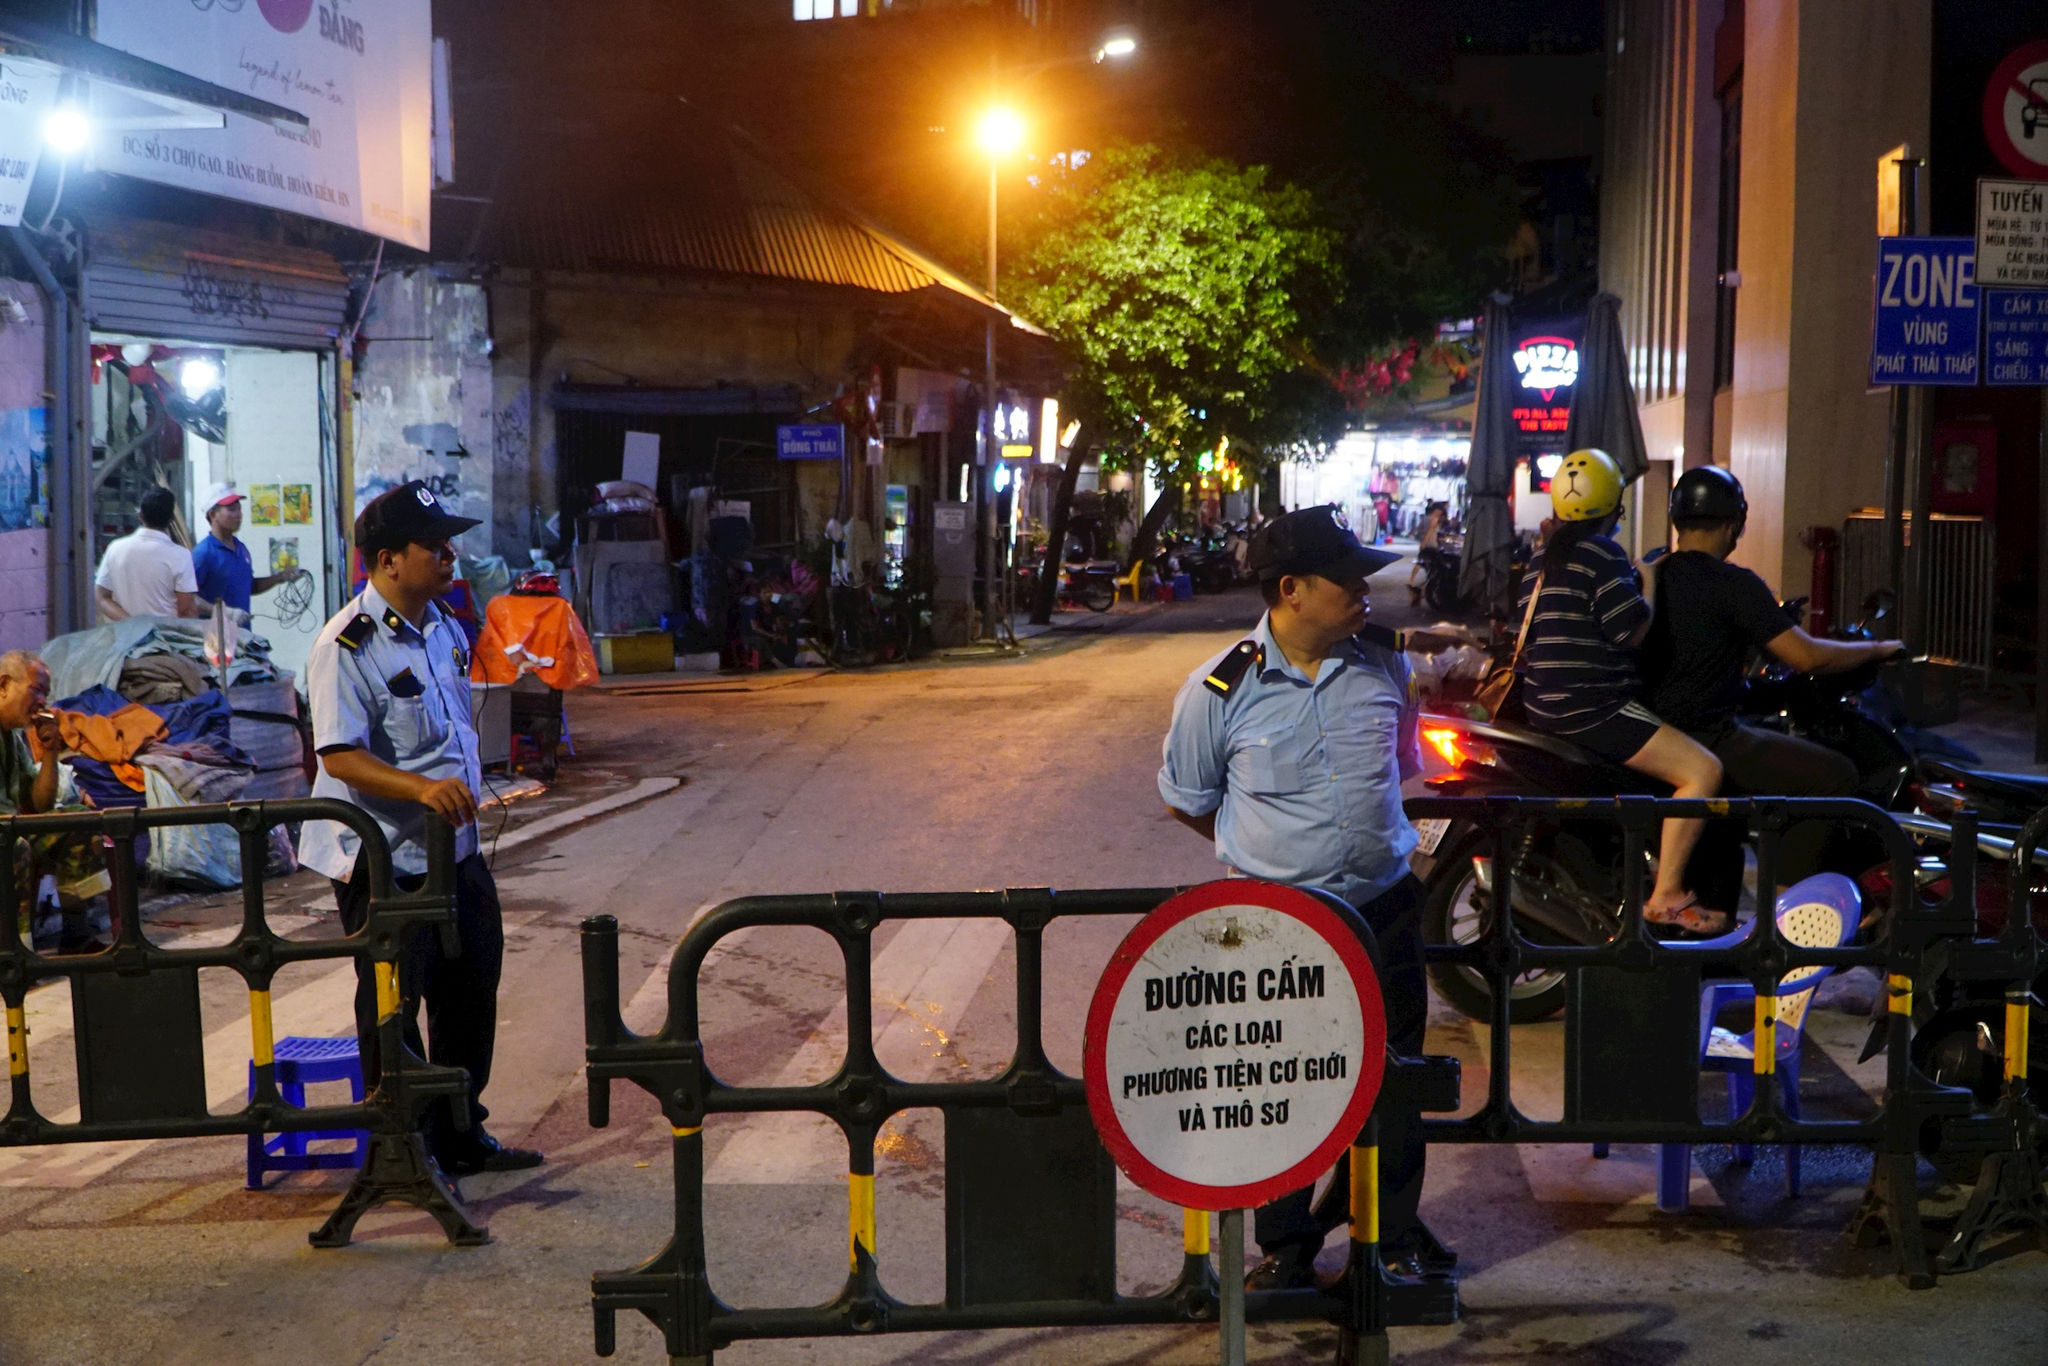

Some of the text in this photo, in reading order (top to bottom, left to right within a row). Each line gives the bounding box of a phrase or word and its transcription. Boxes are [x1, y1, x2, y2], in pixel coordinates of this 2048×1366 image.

[162, 145, 171, 164] 3
[1990, 184, 2043, 213] TUYẾN
[1880, 254, 1975, 308] ZONE
[2003, 294, 2032, 315] CẤM
[1903, 314, 1949, 345] VÙNG
[1513, 345, 1579, 374] PIZZA
[1876, 351, 1907, 374] PHÁT
[1912, 350, 1941, 375] THẢI
[1145, 955, 1324, 1012] ĐƯỜNG CẤM
[1185, 1020, 1282, 1050] CÁC LOẠI
[1123, 1052, 1346, 1098] PHƯƠNG TIỆN CƠ GIỚI
[1178, 1099, 1290, 1132] VÀ THÔ SƠ
